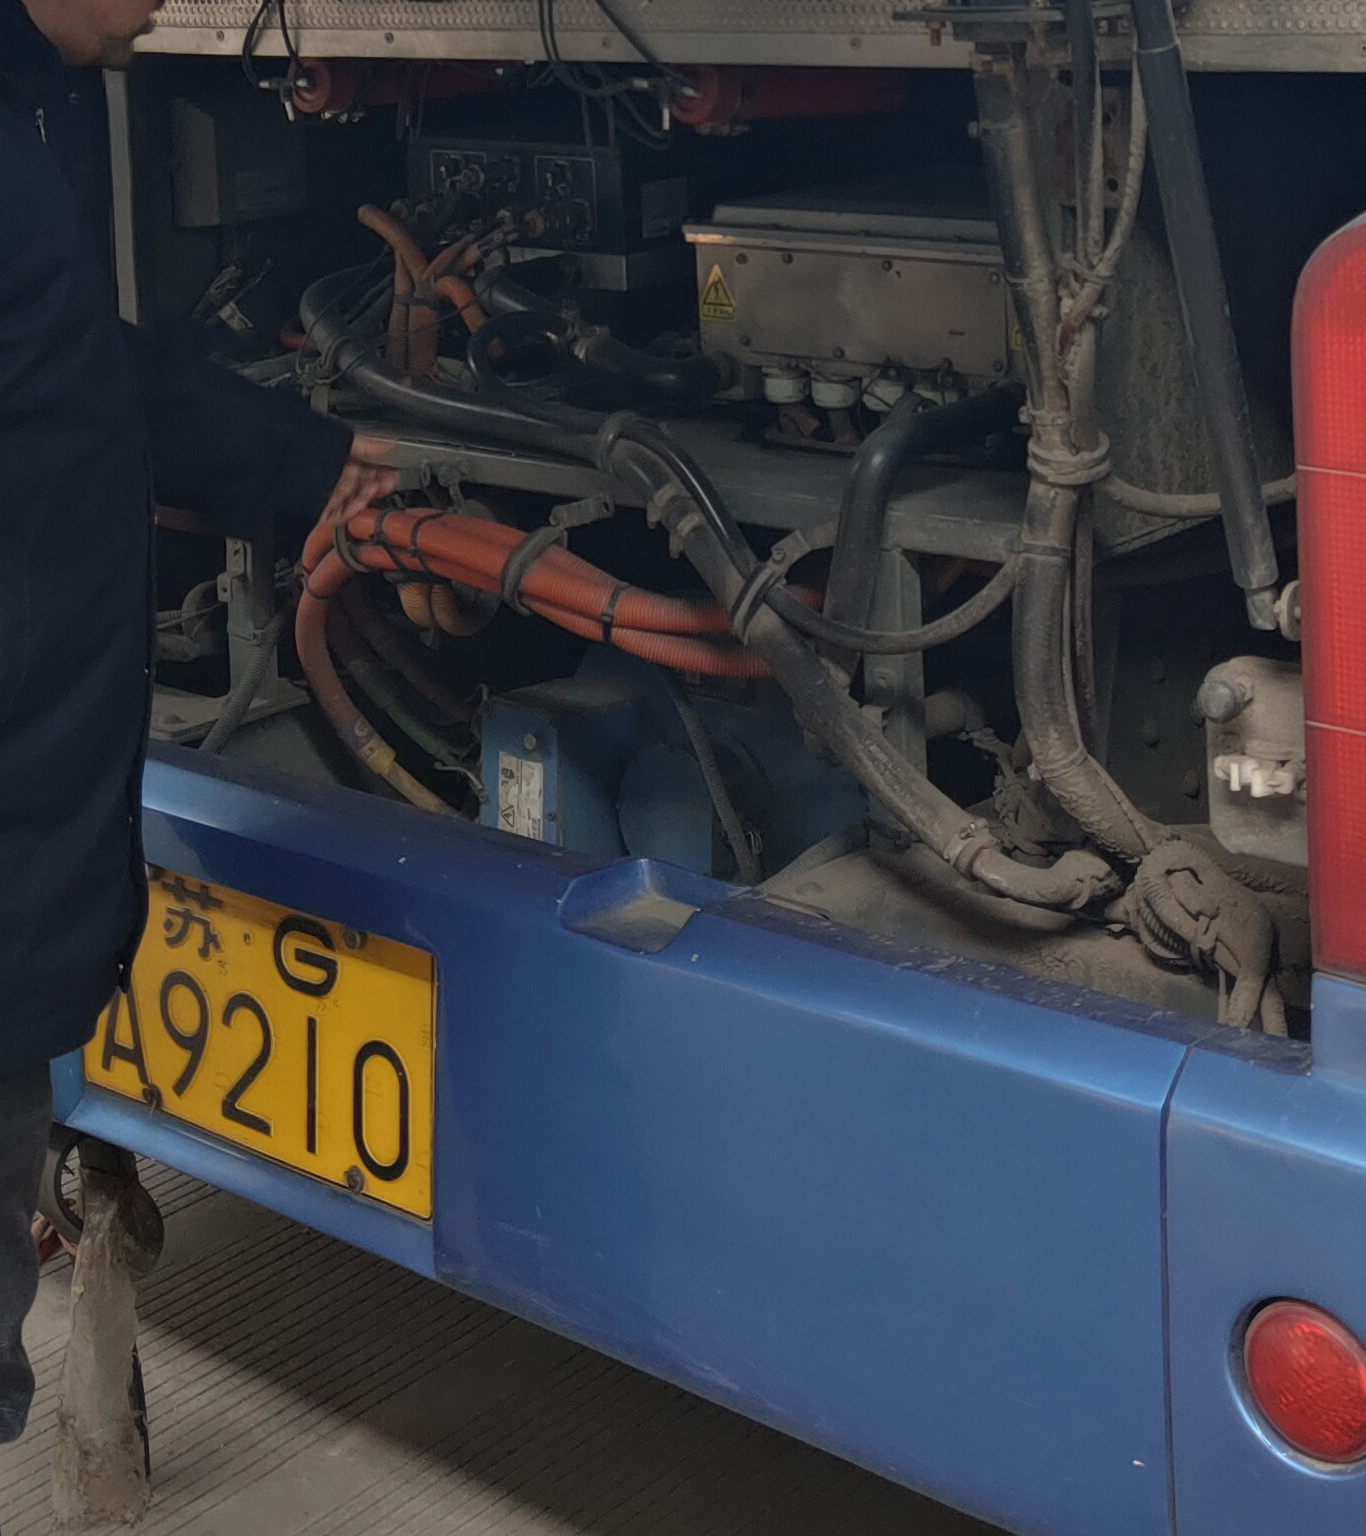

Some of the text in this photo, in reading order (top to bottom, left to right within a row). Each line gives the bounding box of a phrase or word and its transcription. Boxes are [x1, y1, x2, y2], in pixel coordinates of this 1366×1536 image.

[161, 877, 339, 998] 苏 G
[101, 970, 411, 1183] A9210
